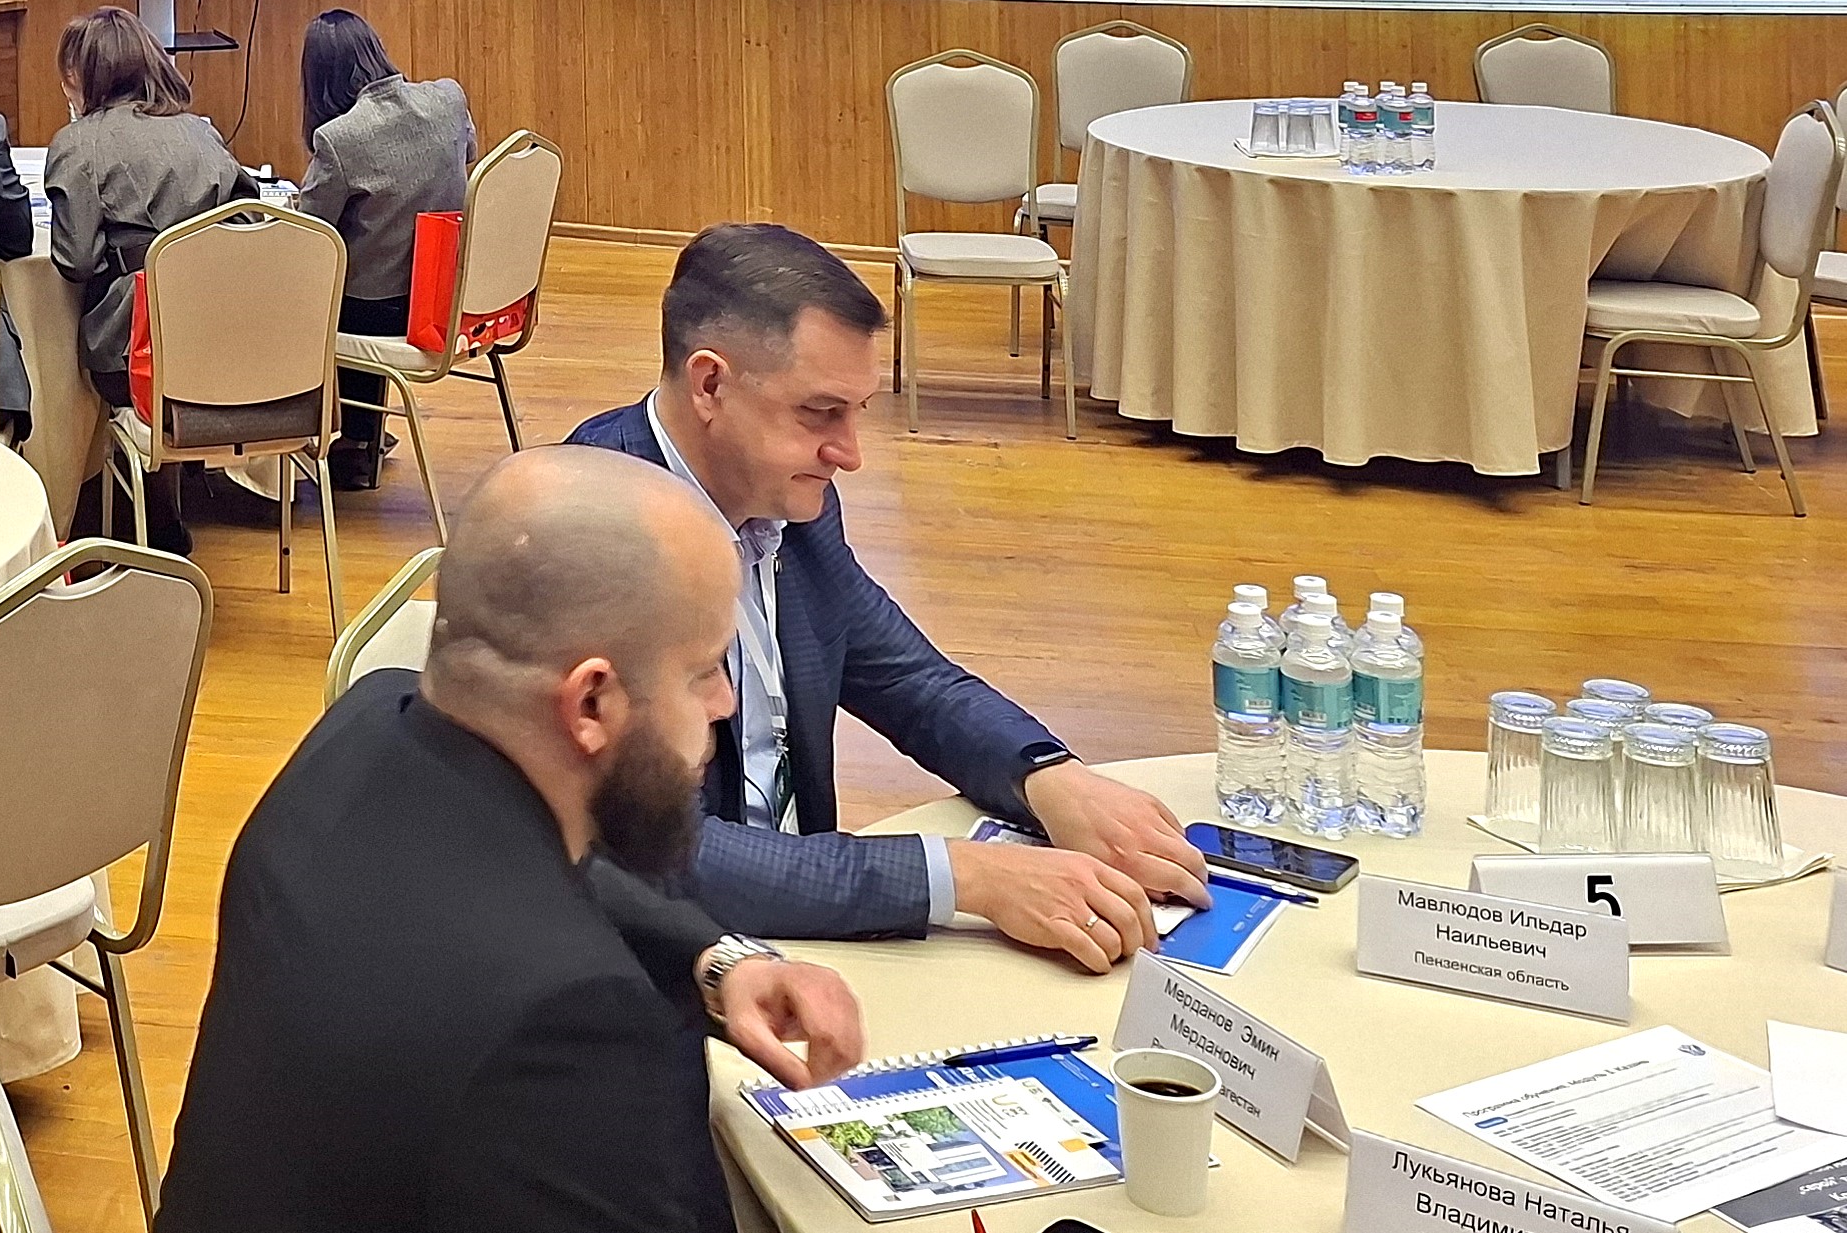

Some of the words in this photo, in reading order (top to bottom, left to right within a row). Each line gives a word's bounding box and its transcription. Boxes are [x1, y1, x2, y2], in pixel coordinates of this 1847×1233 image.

[1398, 889, 1503, 923] Мавлюдов
[1509, 909, 1588, 940] Ильдар
[1585, 875, 1622, 917] 5
[1435, 924, 1547, 959] Наильевич
[1414, 951, 1502, 979] Пензенская
[1506, 969, 1570, 992] область
[1164, 978, 1233, 1033] Мерданов
[1240, 1025, 1280, 1062] Эмин
[1170, 1014, 1256, 1081] Мерданович
[1219, 1083, 1262, 1118] агестан
[1391, 1151, 1516, 1206] Лукьянова
